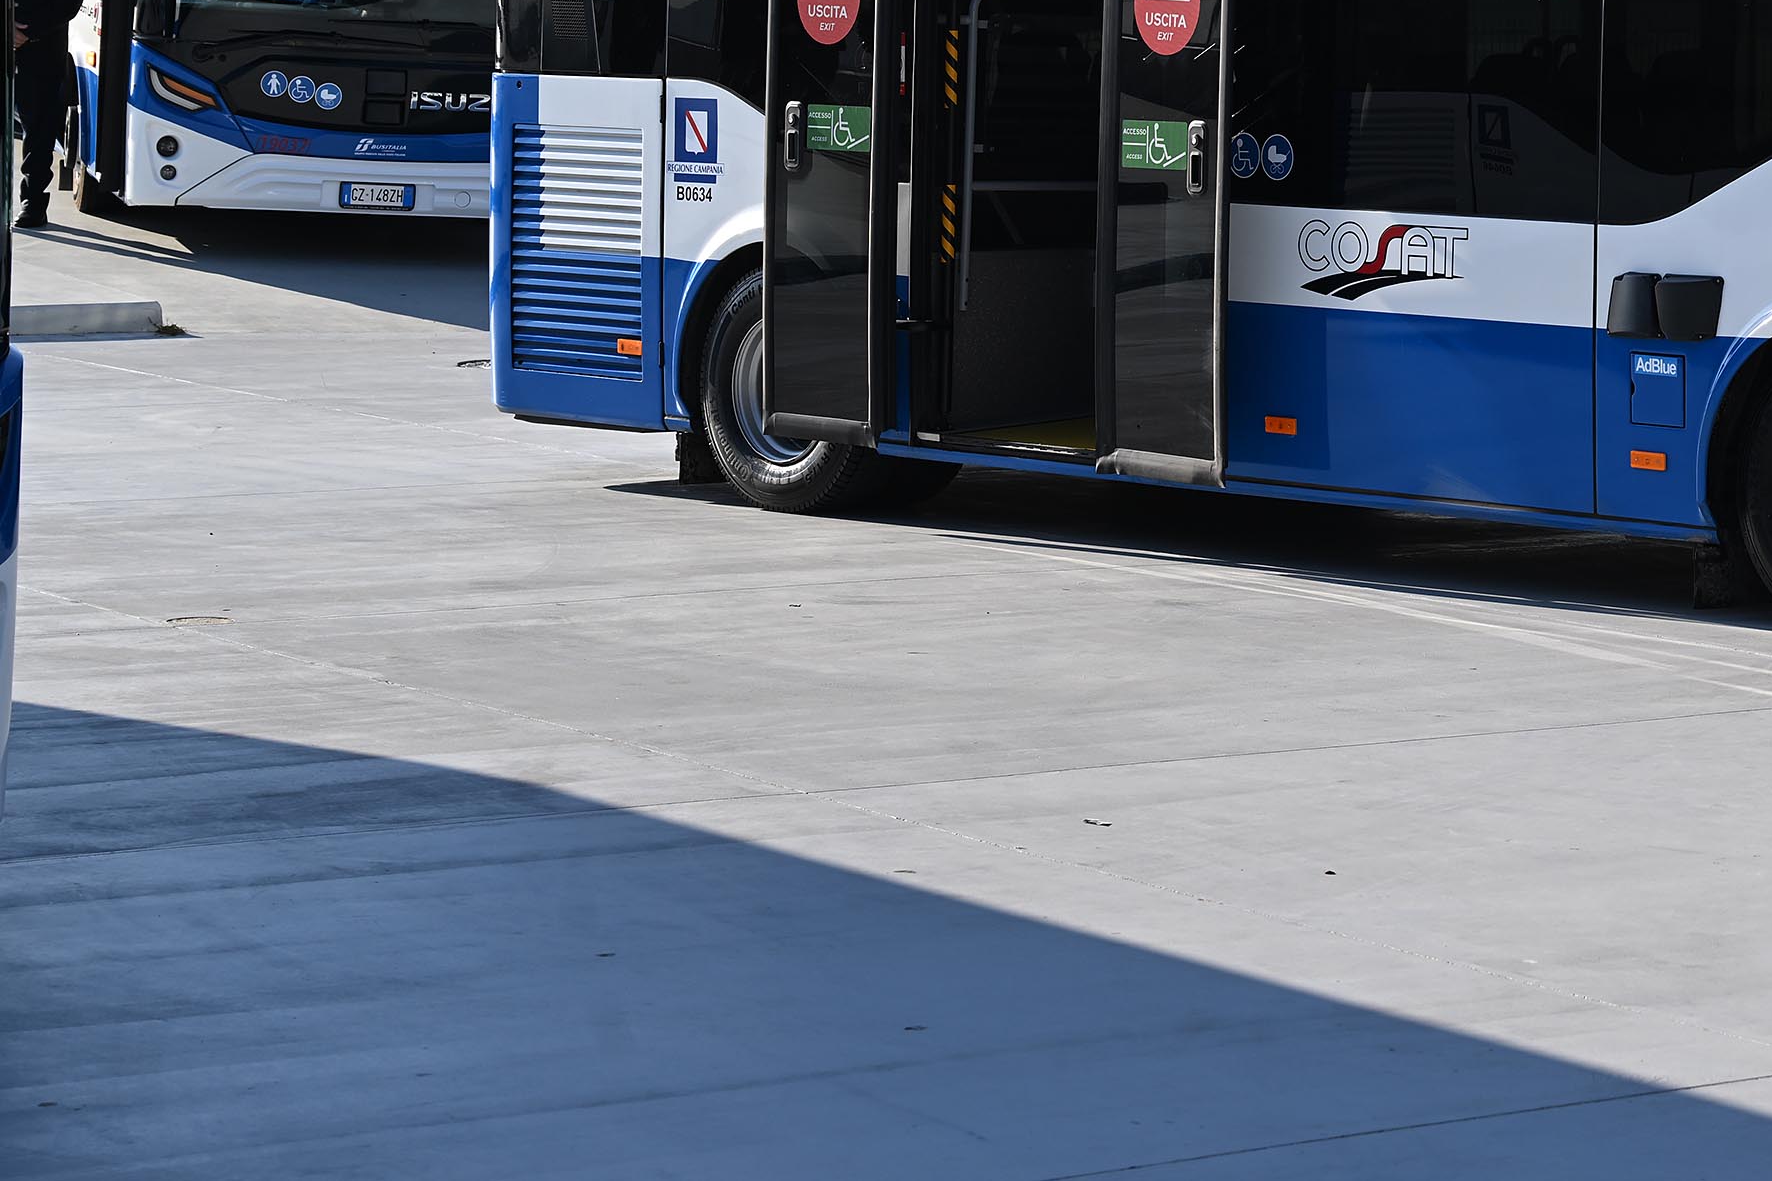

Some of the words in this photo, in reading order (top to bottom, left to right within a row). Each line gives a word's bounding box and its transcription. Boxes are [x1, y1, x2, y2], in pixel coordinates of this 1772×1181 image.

[807, 3, 848, 19] USCITA
[819, 22, 836, 32] EXIT
[1145, 11, 1187, 29] USCITA
[1156, 31, 1174, 41] EXIT
[808, 111, 832, 119] ACCESSO
[1122, 127, 1147, 136] ACCESSO
[667, 163, 693, 173] REGIONE
[694, 164, 724, 174] CAMPANIA
[676, 185, 713, 202] B0634
[1298, 219, 1469, 279] COSAT
[730, 288, 756, 315] Conti
[1635, 356, 1677, 376] AdBlue
